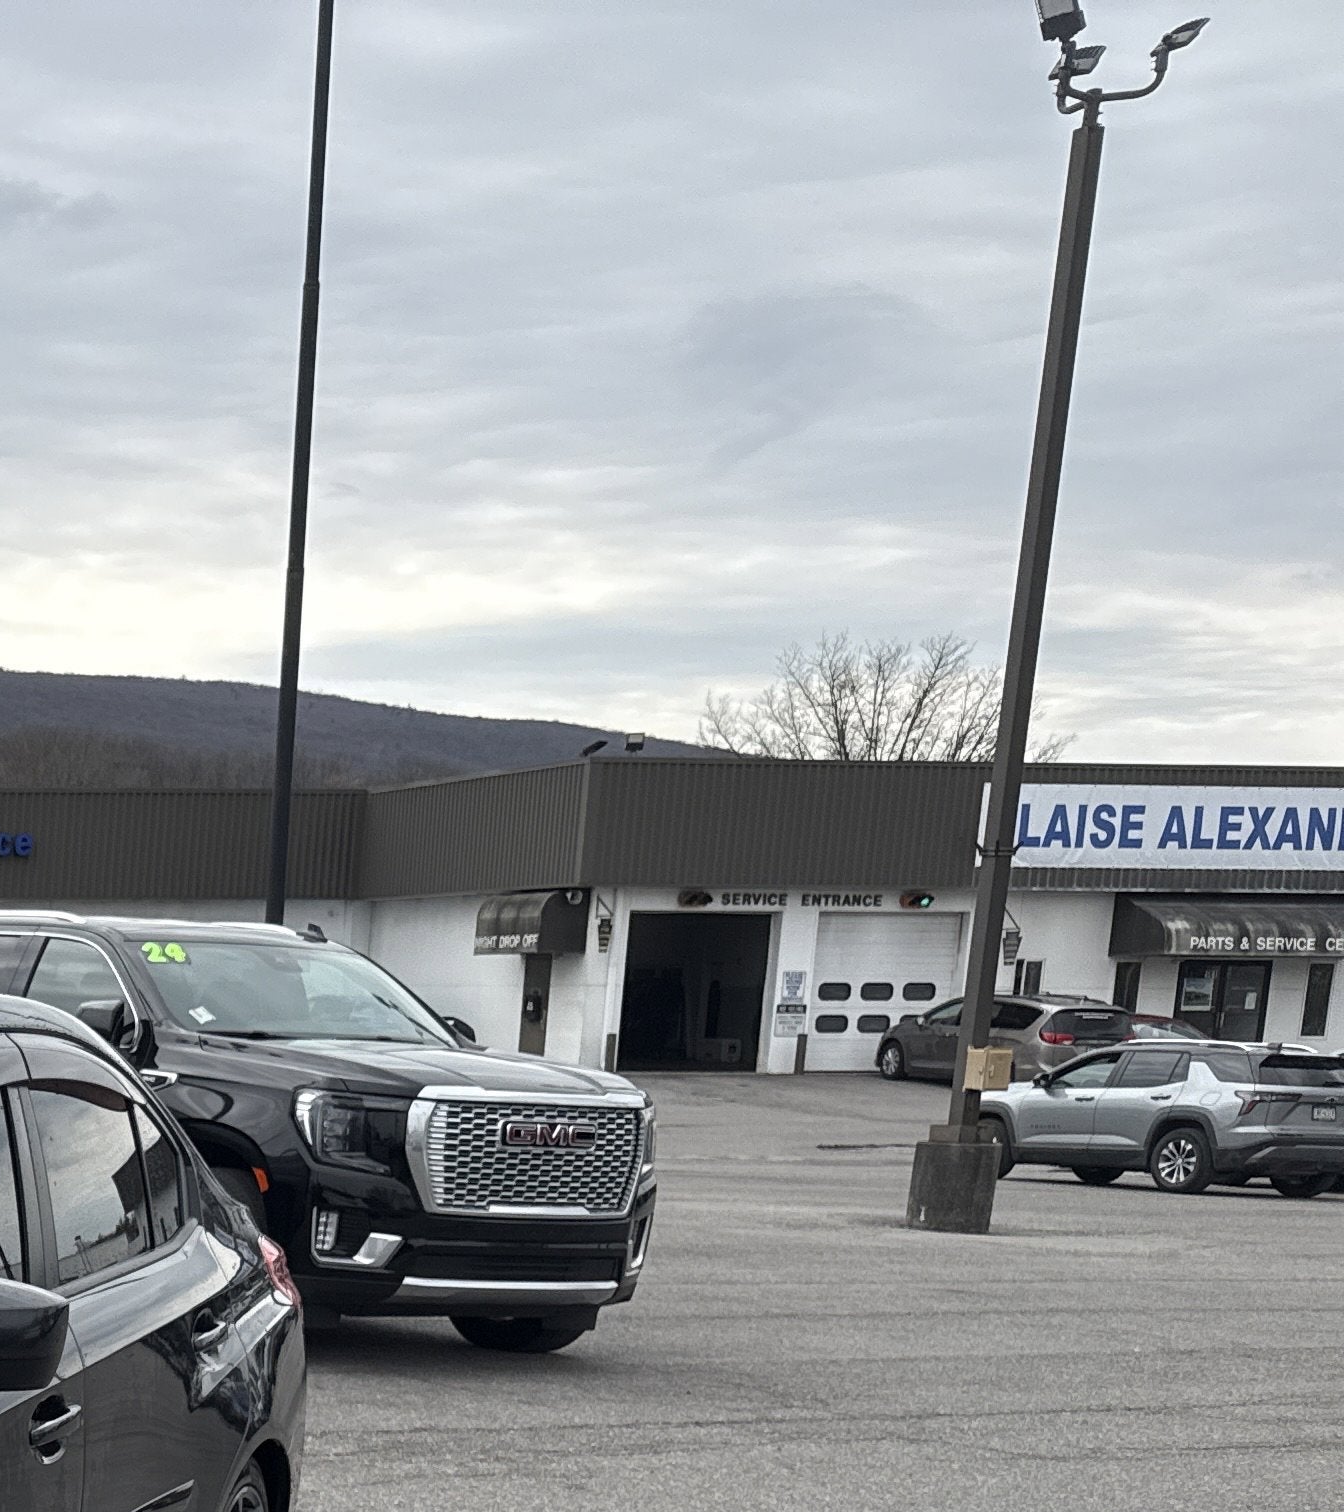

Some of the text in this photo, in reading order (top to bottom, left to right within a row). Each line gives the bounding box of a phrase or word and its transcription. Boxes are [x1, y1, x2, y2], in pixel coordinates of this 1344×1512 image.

[1017, 803, 1344, 851] LAISE ALEXAN
[721, 892, 883, 906] SERVICE ENTRANCE
[499, 934, 521, 949] DROP
[522, 933, 540, 948] OFF
[1190, 936, 1234, 950] PARTS
[1240, 936, 1250, 950] &
[1256, 936, 1316, 951] SERVICE
[141, 942, 186, 963] 24
[505, 1122, 596, 1147] GMC
